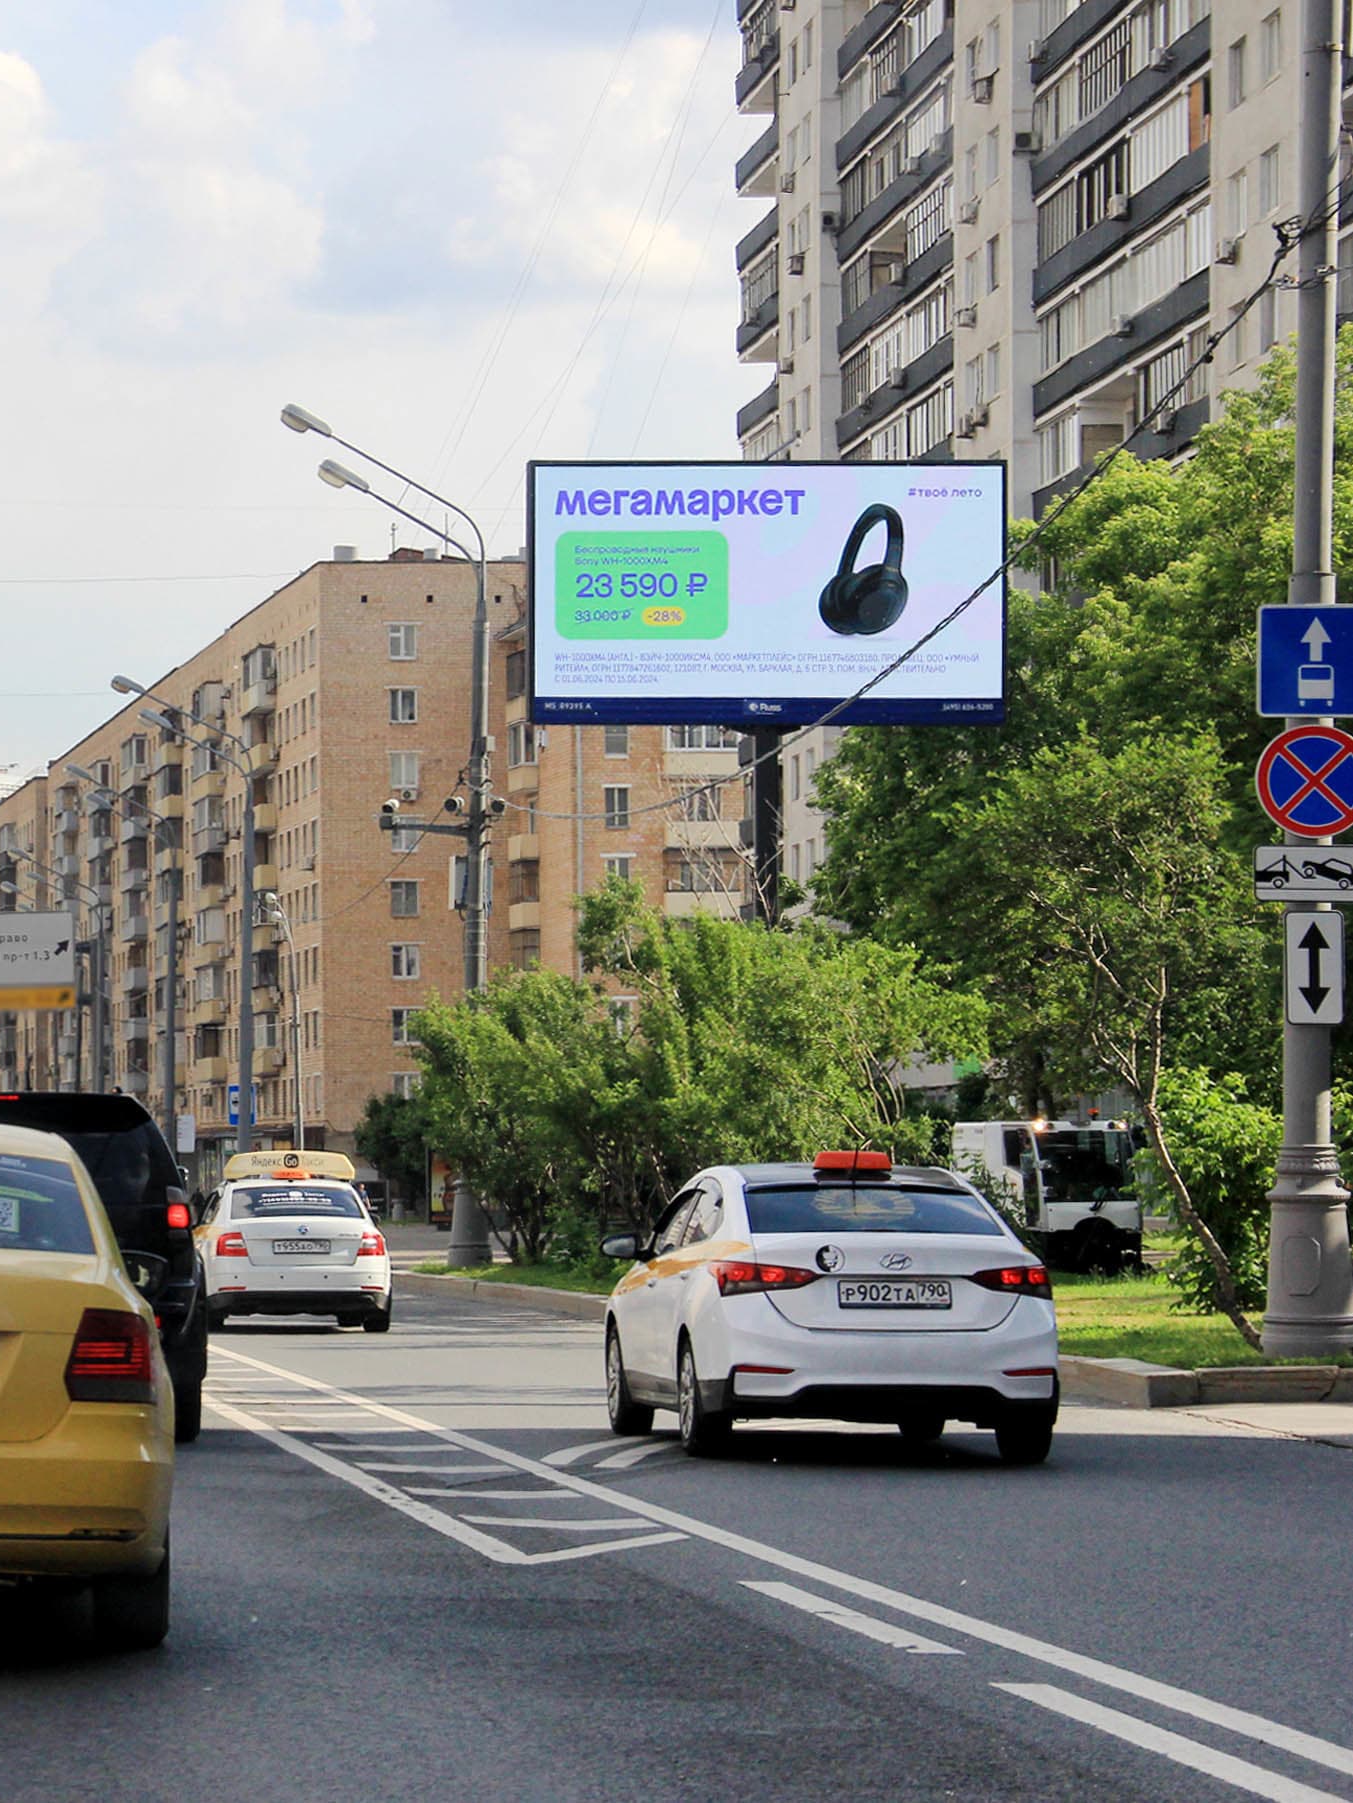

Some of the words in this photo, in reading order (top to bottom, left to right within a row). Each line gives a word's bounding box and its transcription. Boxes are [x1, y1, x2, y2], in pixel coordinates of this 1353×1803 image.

[951, 488, 983, 498] лето
[554, 488, 805, 521] мегамаркет
[647, 610, 683, 623] -28%
[845, 1283, 916, 1302] Р902ТА
[919, 1283, 946, 1298] 790
